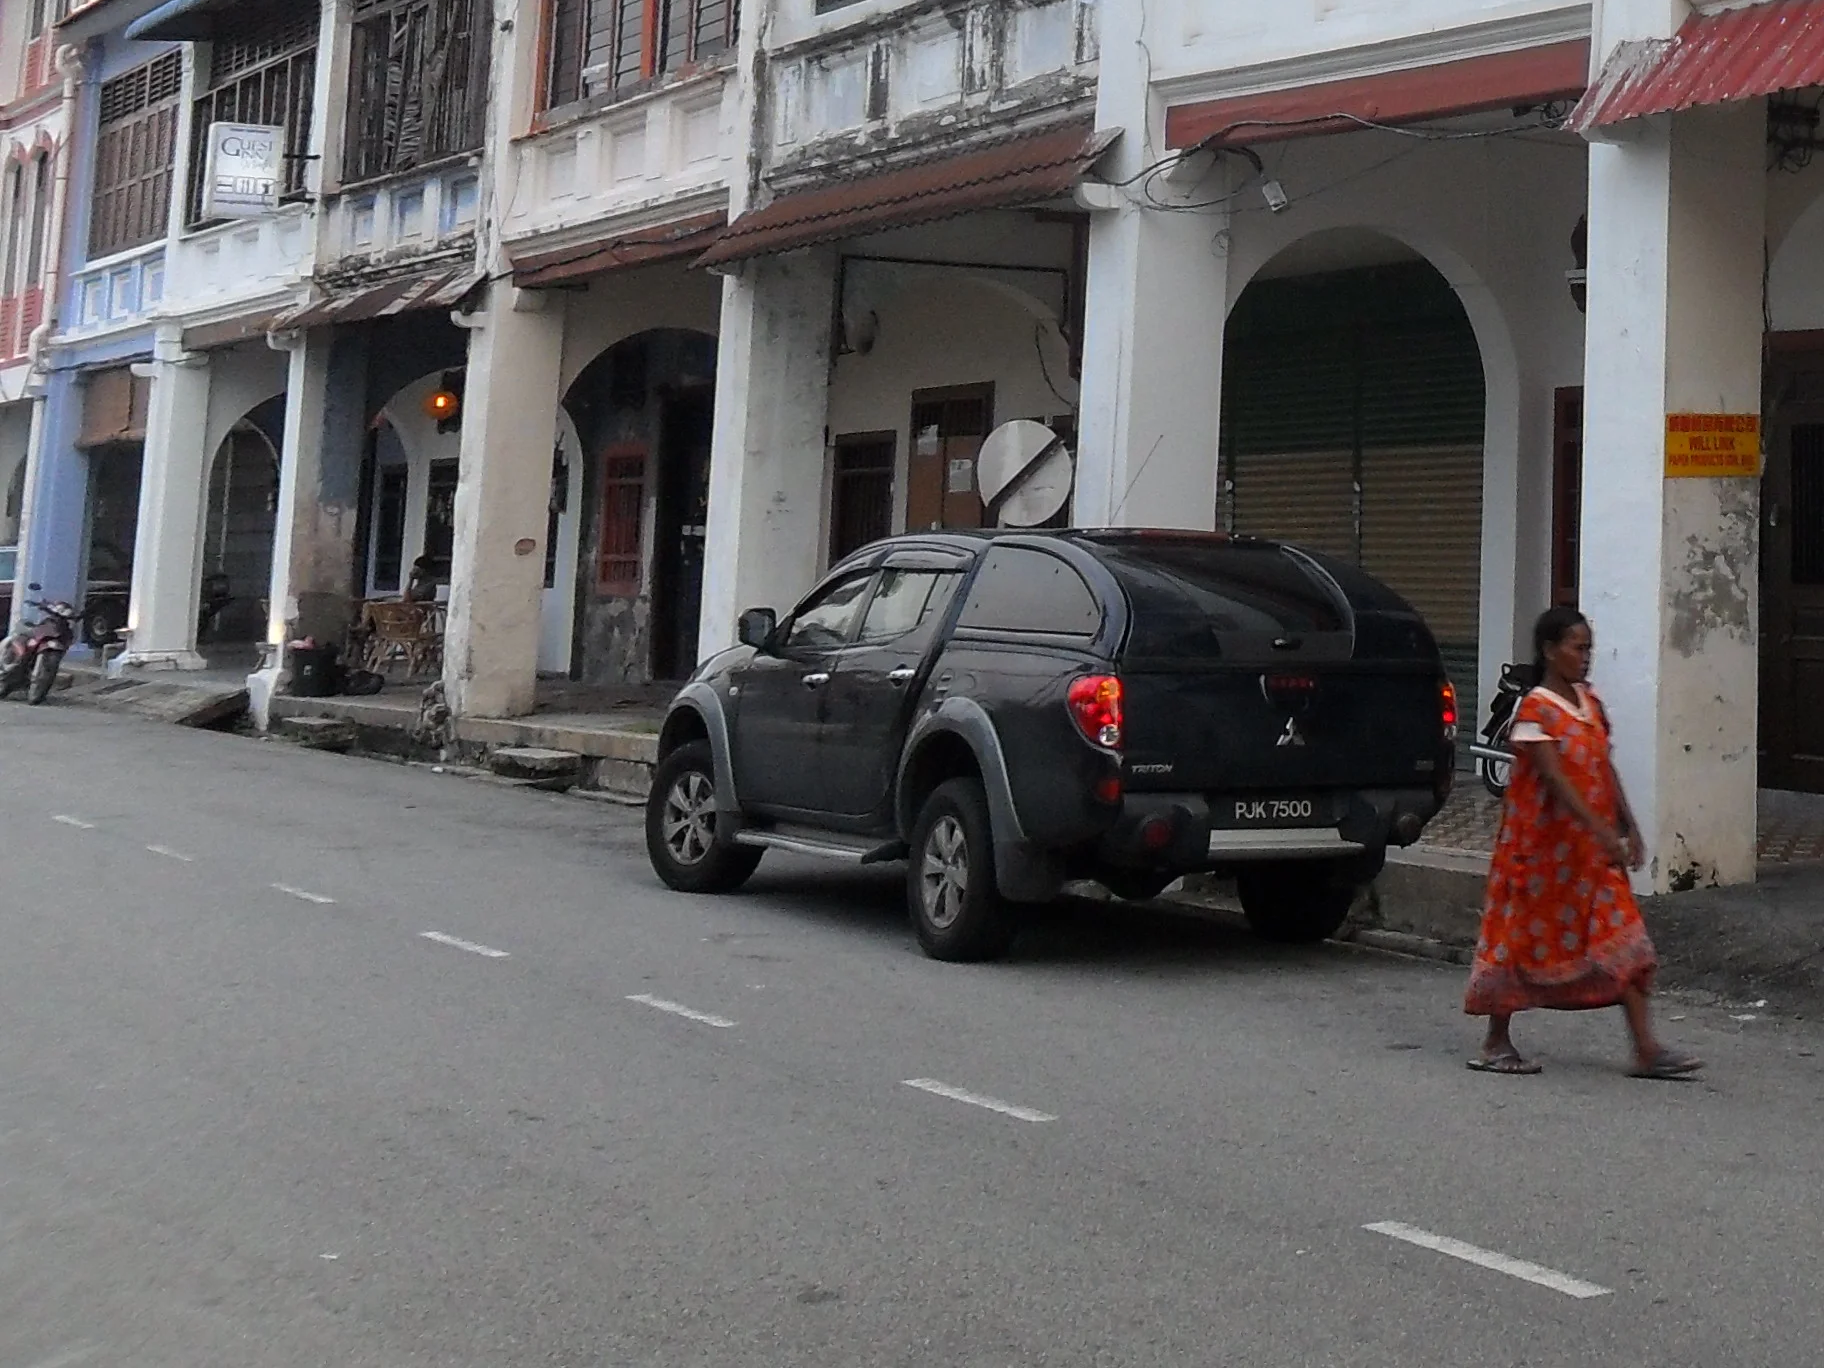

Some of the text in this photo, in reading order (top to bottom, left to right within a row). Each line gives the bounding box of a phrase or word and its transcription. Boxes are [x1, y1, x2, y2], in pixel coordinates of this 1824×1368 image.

[1688, 436, 1711, 451] WILL
[1131, 763, 1173, 774] TRITON
[1235, 800, 1312, 819] PJK 7500
